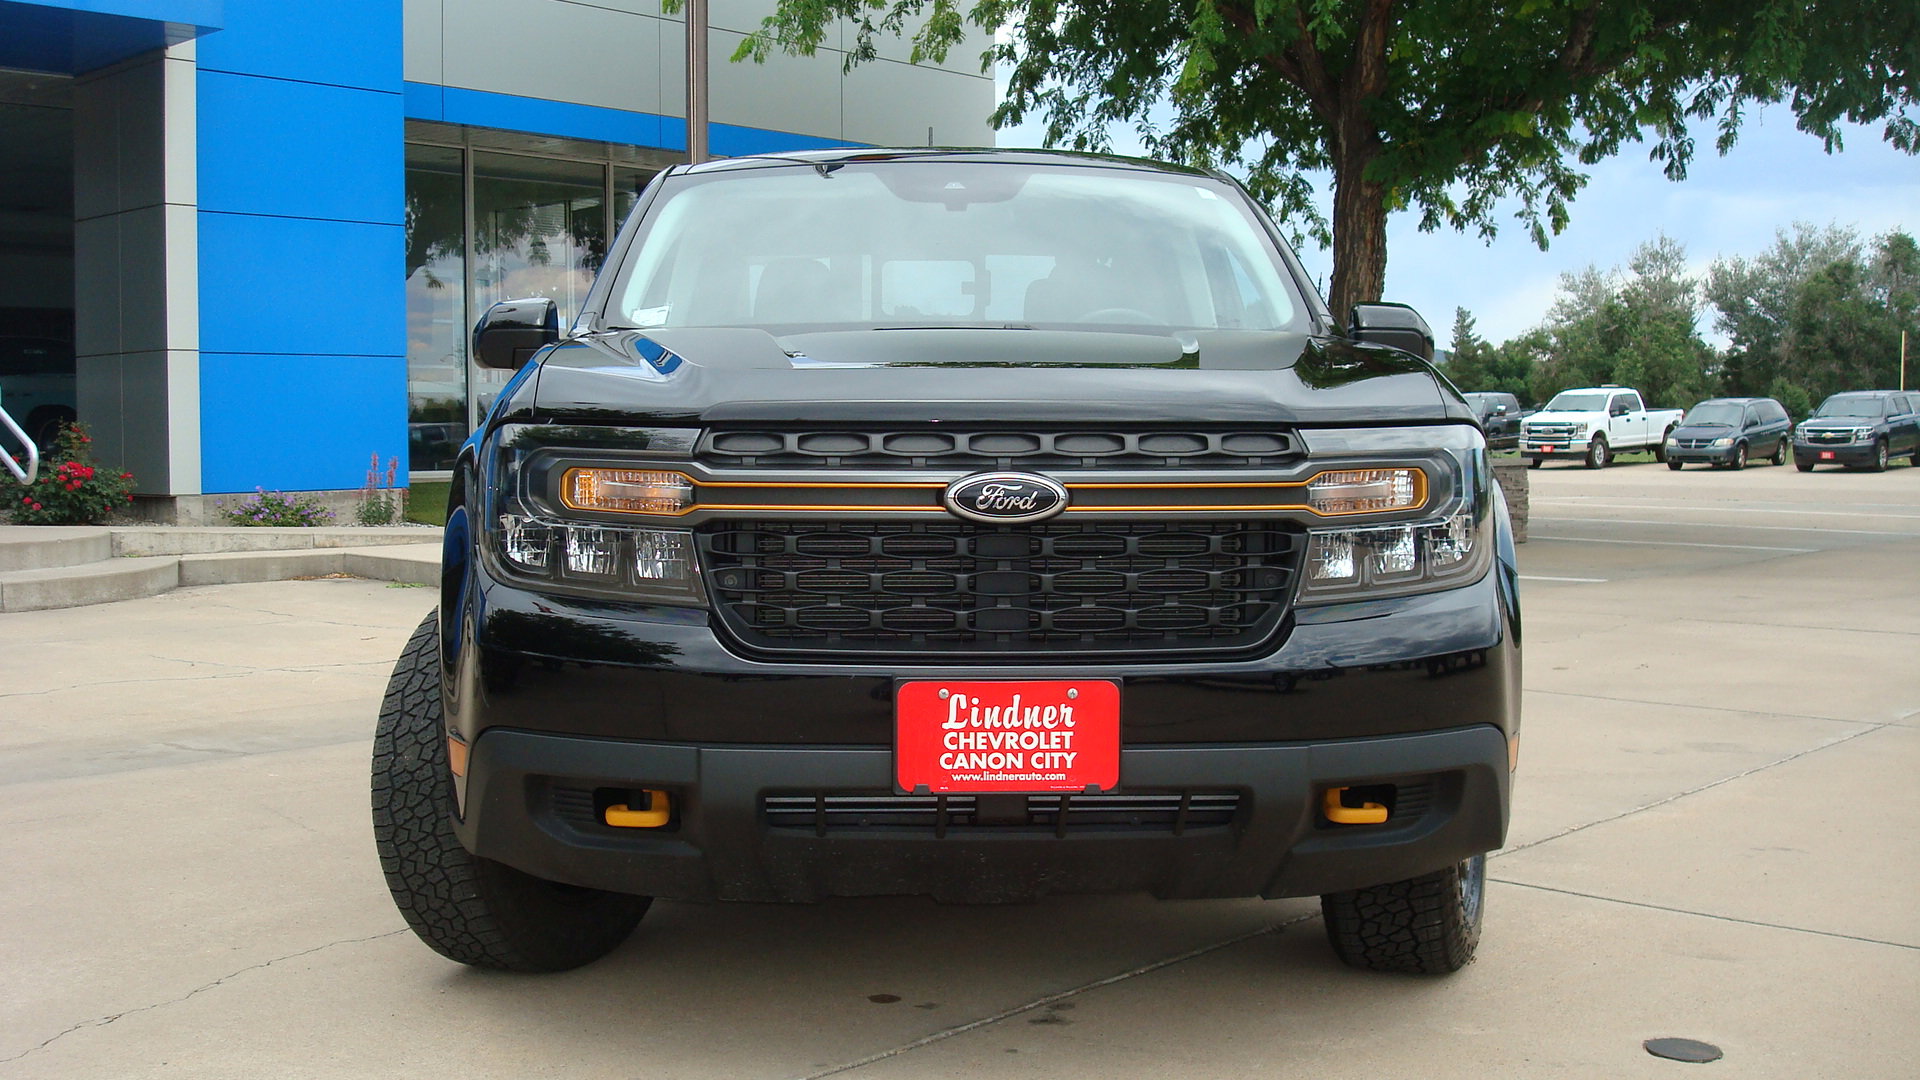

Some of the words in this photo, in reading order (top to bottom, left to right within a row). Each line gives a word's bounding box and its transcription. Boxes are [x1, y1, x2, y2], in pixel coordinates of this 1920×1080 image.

[975, 483, 1038, 510] Ford
[941, 693, 1076, 730] Lindner
[943, 731, 1074, 750] CHEVROLET
[939, 752, 1023, 769] CANON
[1030, 752, 1078, 769] CITY
[951, 771, 1066, 781] www.lindnerauto.com
